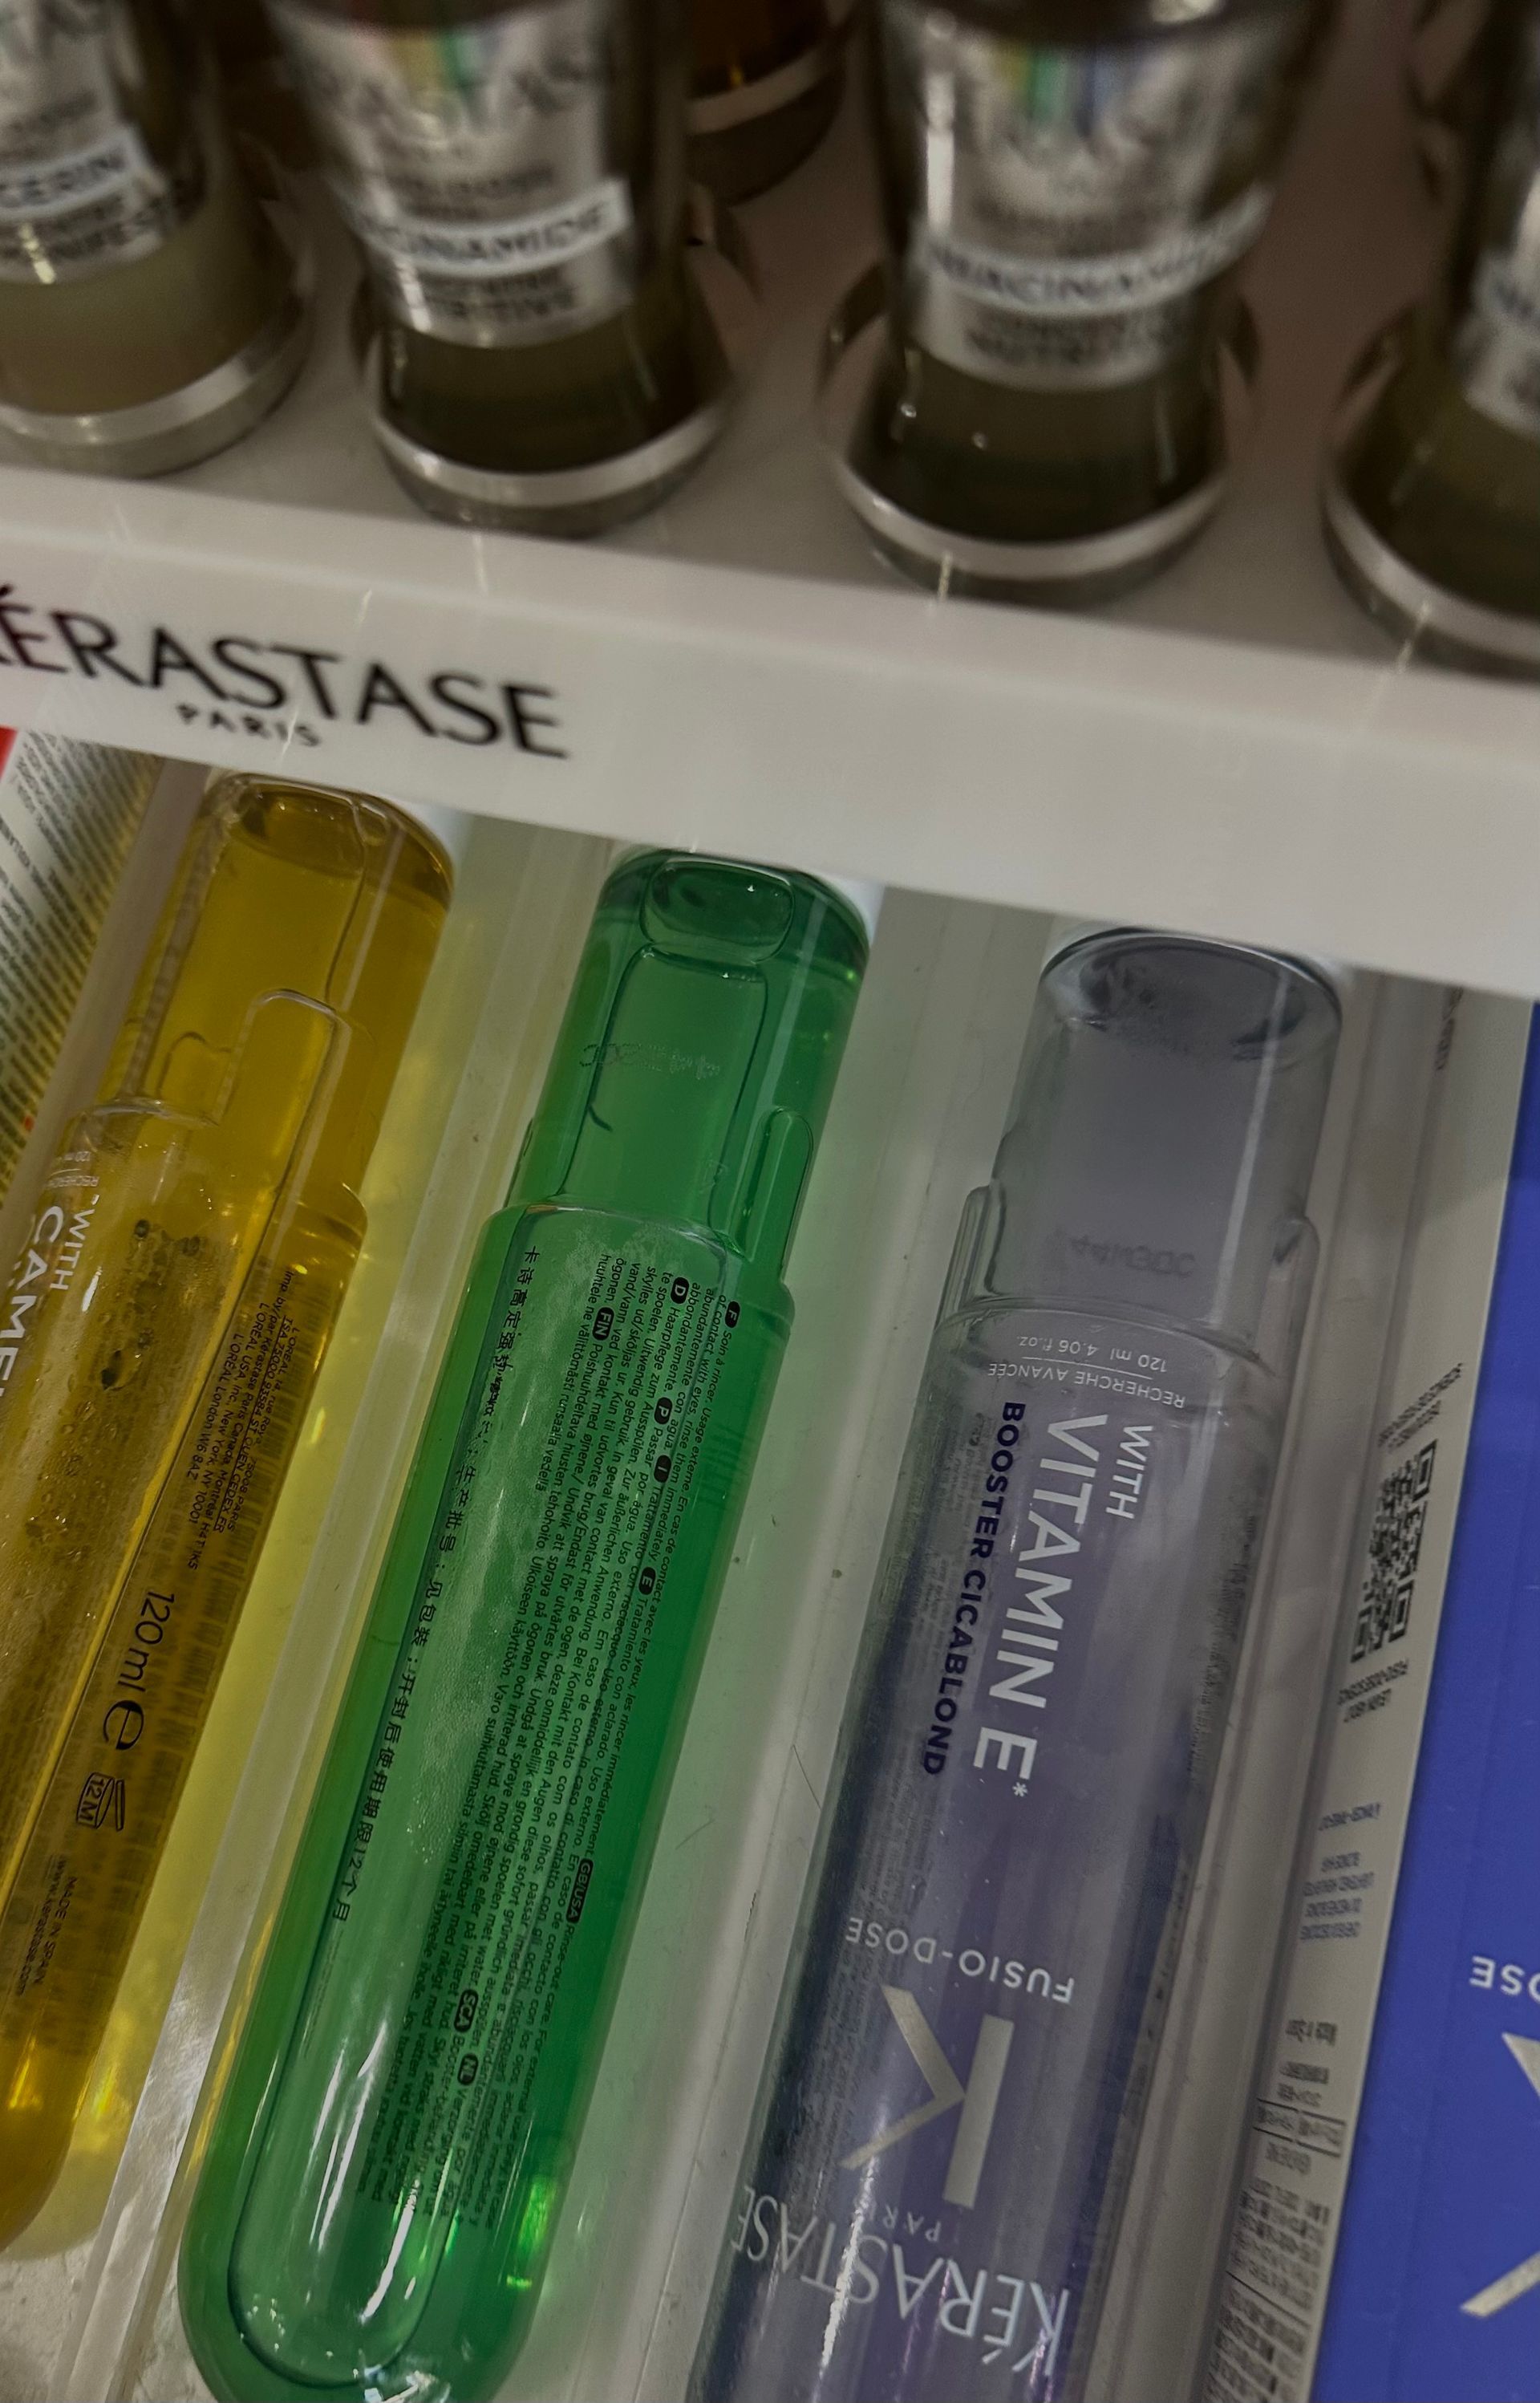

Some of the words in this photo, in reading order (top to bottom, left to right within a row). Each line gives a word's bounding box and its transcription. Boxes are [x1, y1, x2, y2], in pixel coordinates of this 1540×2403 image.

[0, 585, 567, 759] ÉRASTASE
[176, 702, 322, 748] PARIS
[50, 1209, 95, 1289] WITH
[637, 1264, 657, 1305] skylles
[660, 1270, 675, 1285] te
[0, 1205, 64, 1398] CAME
[715, 1293, 727, 1309] of
[245, 1301, 270, 1353] L'ORÉAL
[608, 1326, 622, 1351] ved
[651, 1305, 680, 1370] Haarpflege
[680, 1286, 714, 1386] abundantemente
[703, 1309, 721, 1355] contact
[717, 1329, 733, 1356] Soin
[1059, 1339, 1098, 1357] 4.06
[1110, 1348, 1133, 1362] ml
[1138, 1354, 1168, 1373] 120
[233, 1354, 252, 1382] USA,
[594, 1352, 618, 1399] kontakt
[626, 1337, 656, 1398] Uitwendig
[695, 1358, 709, 1384] with
[987, 1362, 1069, 1382] AVANCÉE
[565, 1342, 604, 1439] Poishuuhdeltava
[645, 1372, 659, 1398] zum
[1074, 1370, 1186, 1409] RECHERCHE
[202, 1385, 226, 1430] London
[236, 1391, 253, 1420] Paris
[265, 1394, 276, 1414] rue
[586, 1401, 601, 1431] med
[606, 1390, 624, 1415] Kun
[672, 1390, 685, 1414] con
[216, 1409, 233, 1435] New
[602, 1418, 617, 1432] til
[678, 1419, 694, 1449] rinse
[693, 1406, 713, 1444] Usage
[194, 1431, 211, 1452] W6
[205, 1437, 224, 1467] York,
[611, 1450, 626, 1463] In
[642, 1426, 663, 1467] Passar
[185, 1453, 203, 1480] 8AZ
[552, 1441, 576, 1487] hiusten
[586, 1433, 610, 1489] udvortes
[668, 1451, 686, 1484] them
[1105, 1425, 1153, 1520] WITH
[199, 1469, 213, 1488] NY
[602, 1463, 618, 1500] geval
[620, 1467, 636, 1490] Zur
[635, 1471, 648, 1495] por
[971, 1400, 1027, 1559] BOOSTER
[187, 1489, 207, 1524] 10001
[225, 1495, 245, 1532] PARIS
[557, 1486, 581, 1530] Undvik
[594, 1501, 608, 1524] van
[675, 1495, 689, 1512] En
[669, 1513, 681, 1535] cas
[551, 1532, 565, 1553] att
[581, 1526, 602, 1576] contact
[616, 1539, 633, 1565] Uso
[663, 1536, 678, 1556] de
[537, 1553, 558, 1598] spraya
[989, 1413, 1108, 1709] VITAMIN
[516, 1554, 544, 1616] Ulkoiseen
[573, 1577, 587, 1604] met
[650, 1555, 670, 1604] contact
[135, 1590, 176, 1646] 120
[568, 1604, 583, 1623] de
[642, 1604, 657, 1635] avec
[593, 1628, 609, 1651] Em
[618, 1596, 647, 1673] Tratamiento
[637, 1636, 650, 1655] les
[117, 1648, 151, 1693] ml
[923, 1564, 987, 1776] CICABLOND
[845, 1917, 1076, 2005] FUSIO-DOSE
[730, 2185, 1070, 2377] KÉRASTASE
